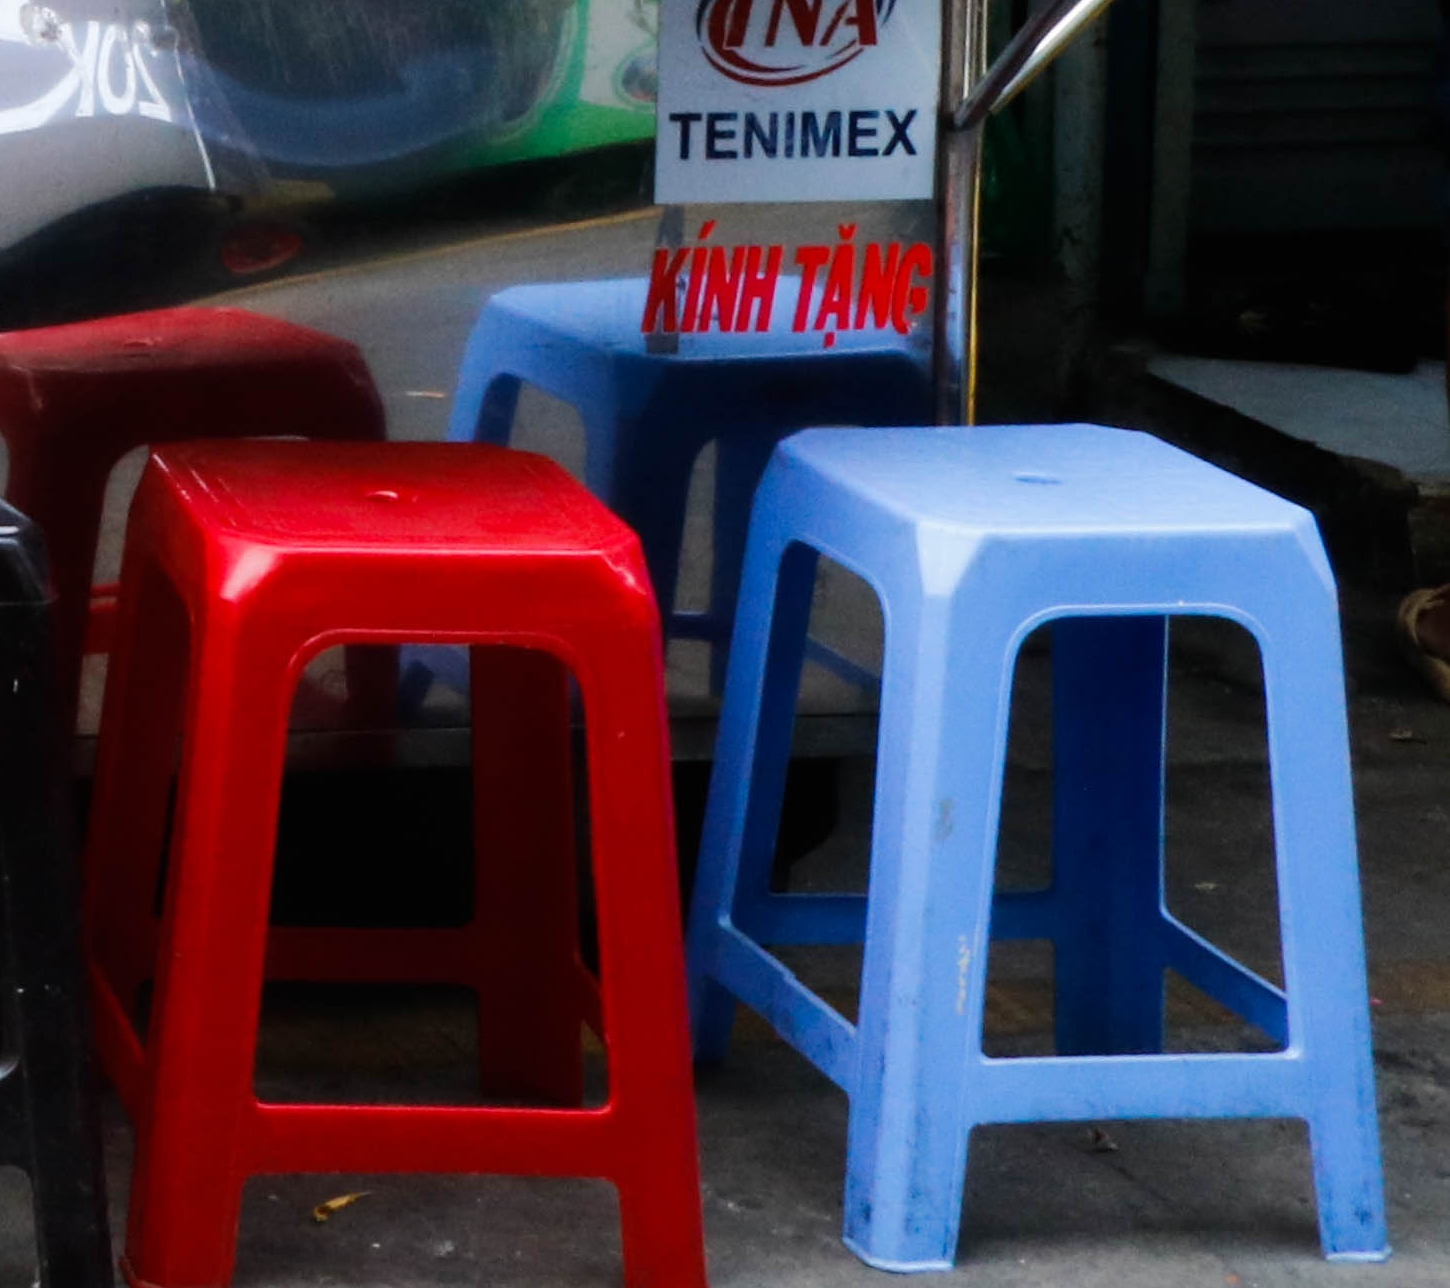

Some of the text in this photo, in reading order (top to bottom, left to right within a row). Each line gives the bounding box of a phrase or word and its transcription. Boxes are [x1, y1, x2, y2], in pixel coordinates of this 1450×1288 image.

[669, 109, 917, 160] TENIMEX
[641, 220, 933, 348] KÍNH TẶNG
